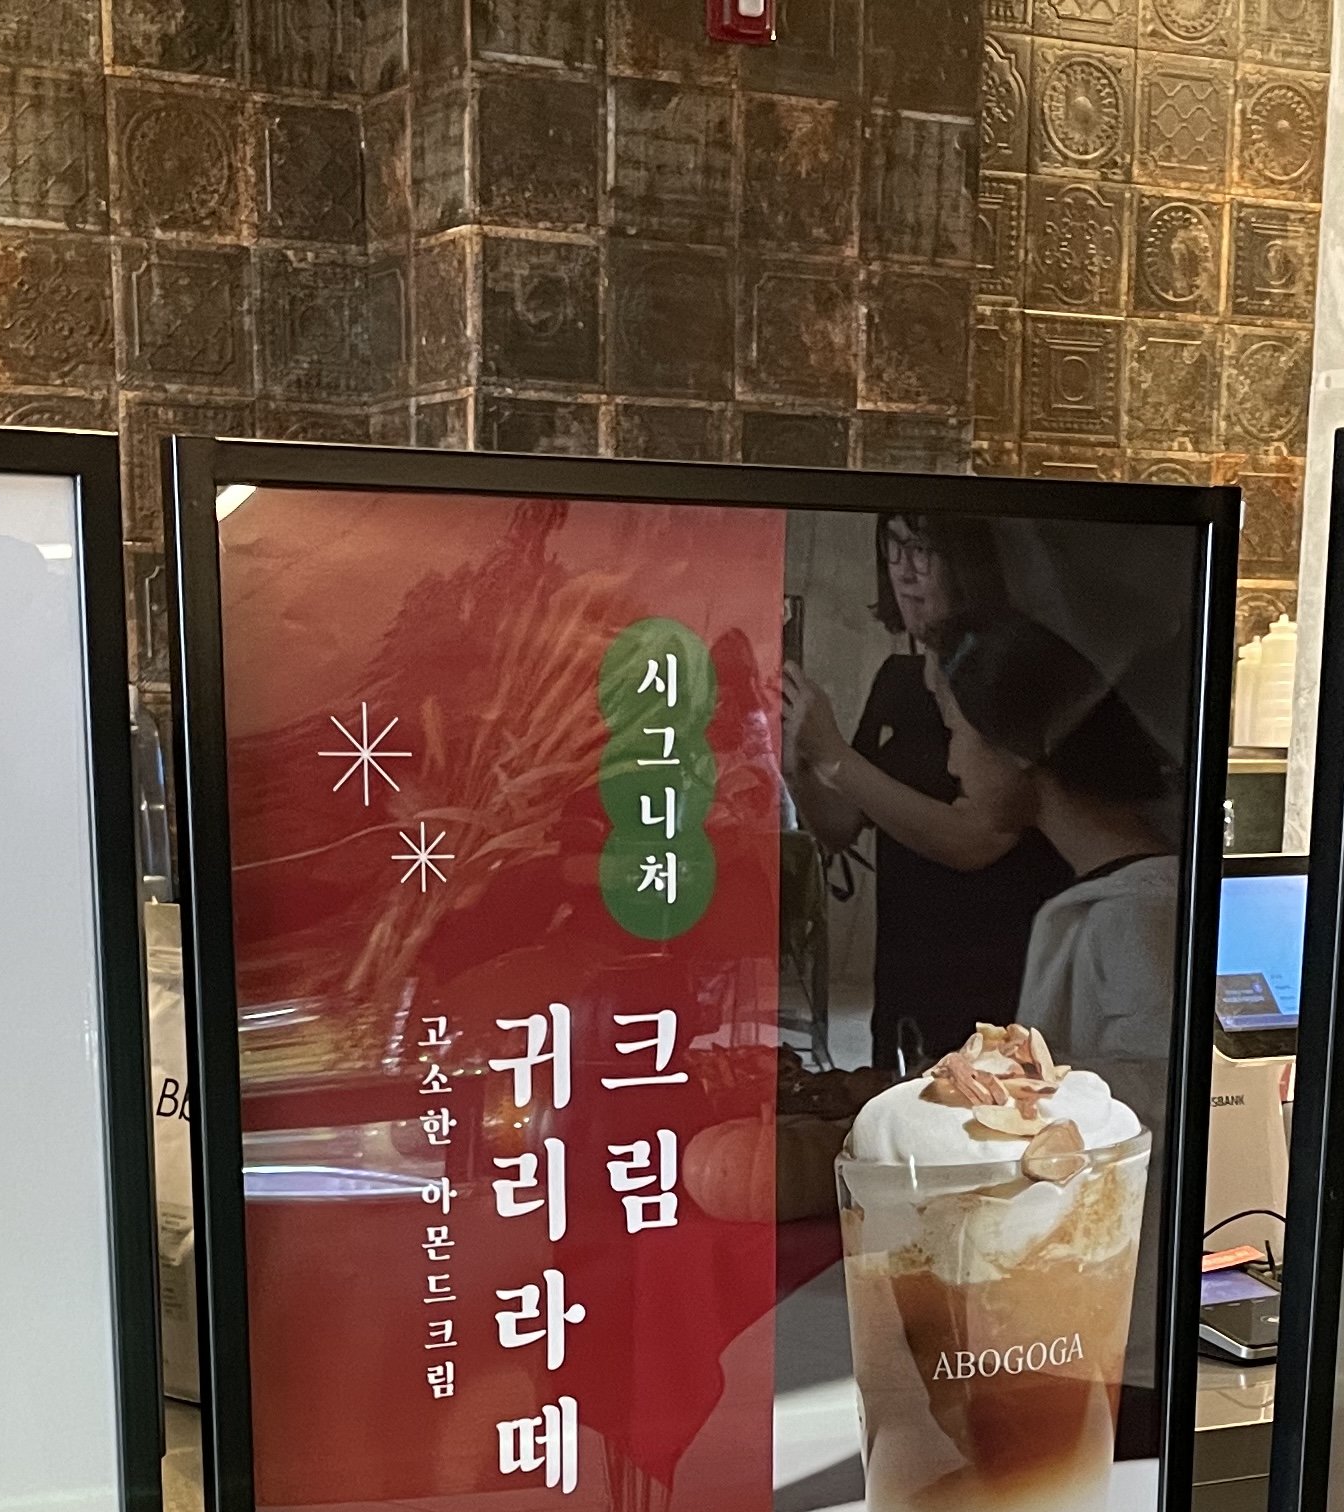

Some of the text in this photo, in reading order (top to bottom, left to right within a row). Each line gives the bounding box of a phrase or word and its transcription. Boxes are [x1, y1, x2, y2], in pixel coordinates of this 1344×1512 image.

[637, 653, 680, 904] 시그니처
[417, 1016, 457, 1399] 고소한 아몬드크림
[600, 1009, 689, 1234] 크림
[488, 1003, 586, 1494] 귀리라떼
[932, 1333, 1085, 1381] ABOGOGA
